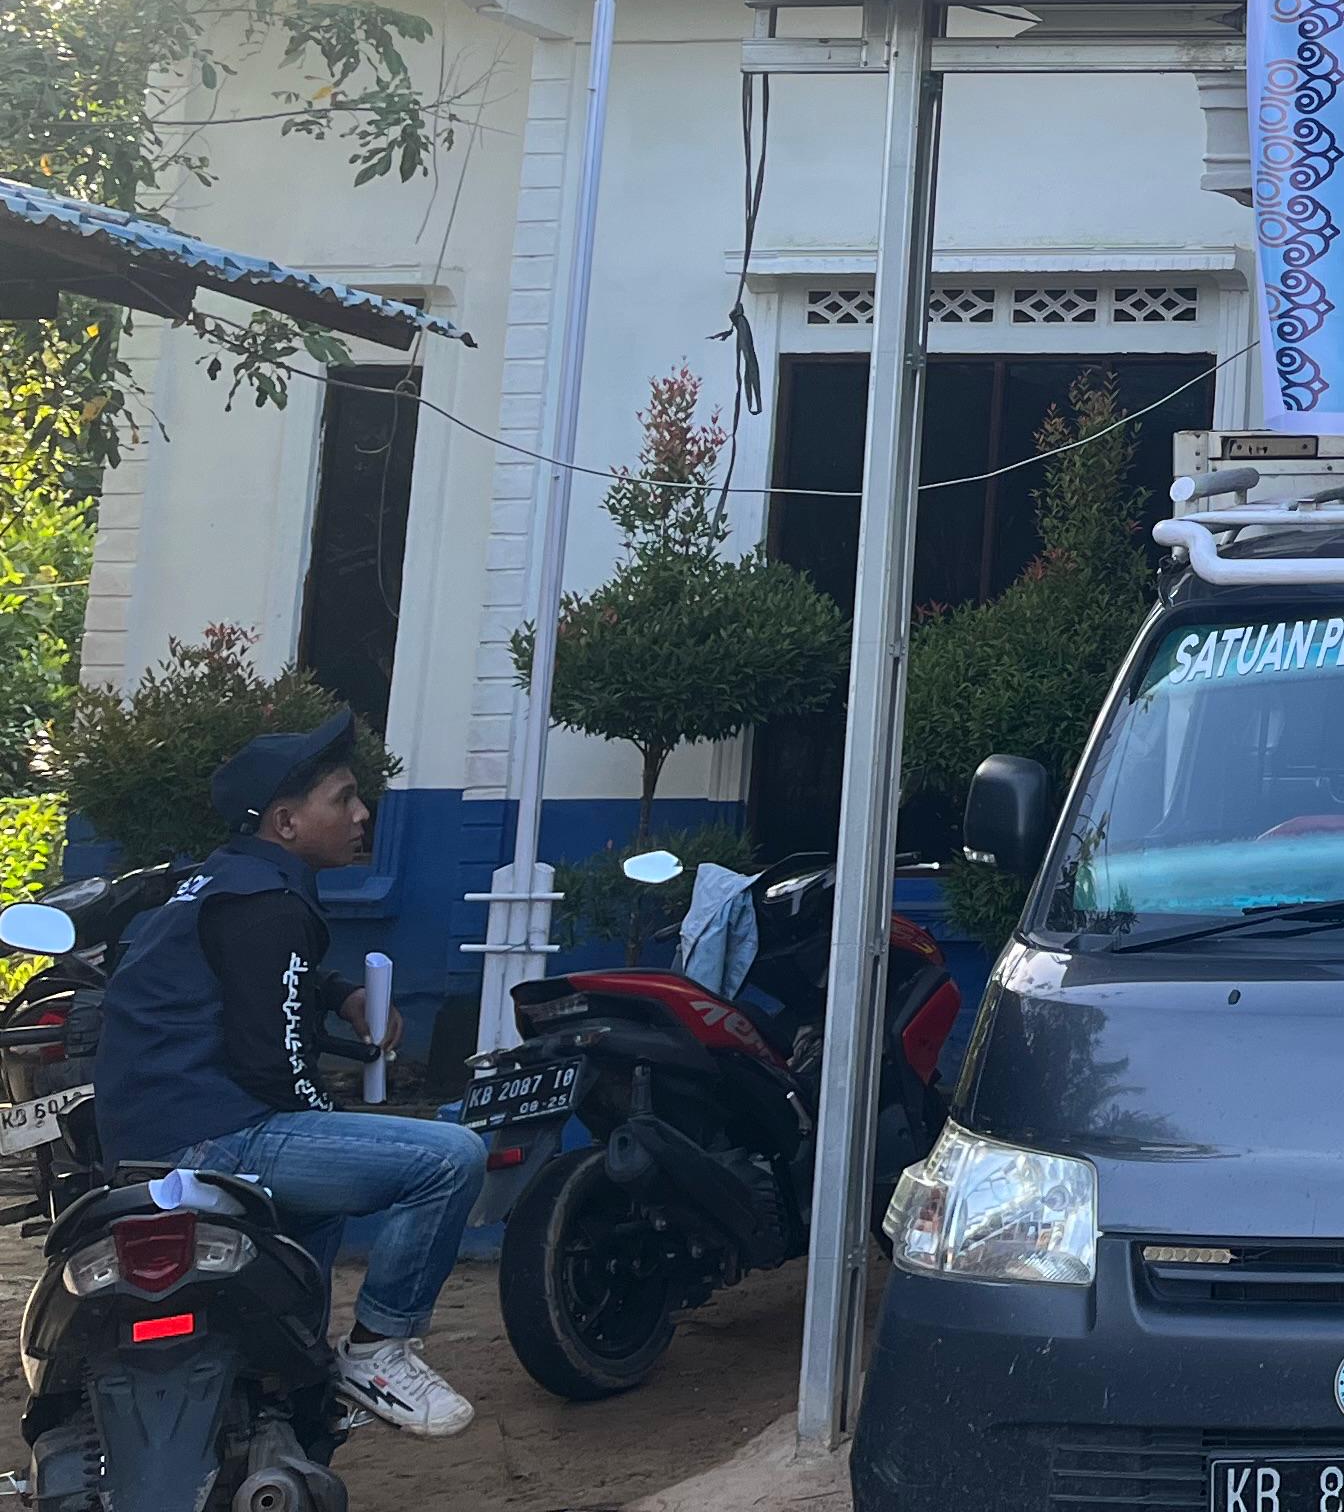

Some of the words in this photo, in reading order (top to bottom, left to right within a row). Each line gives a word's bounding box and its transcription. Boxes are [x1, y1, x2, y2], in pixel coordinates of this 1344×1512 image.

[1168, 619, 1318, 684] SATUAN
[469, 1086, 493, 1108] KB
[498, 1074, 543, 1101] 2087
[1227, 1467, 1281, 1512] KB
